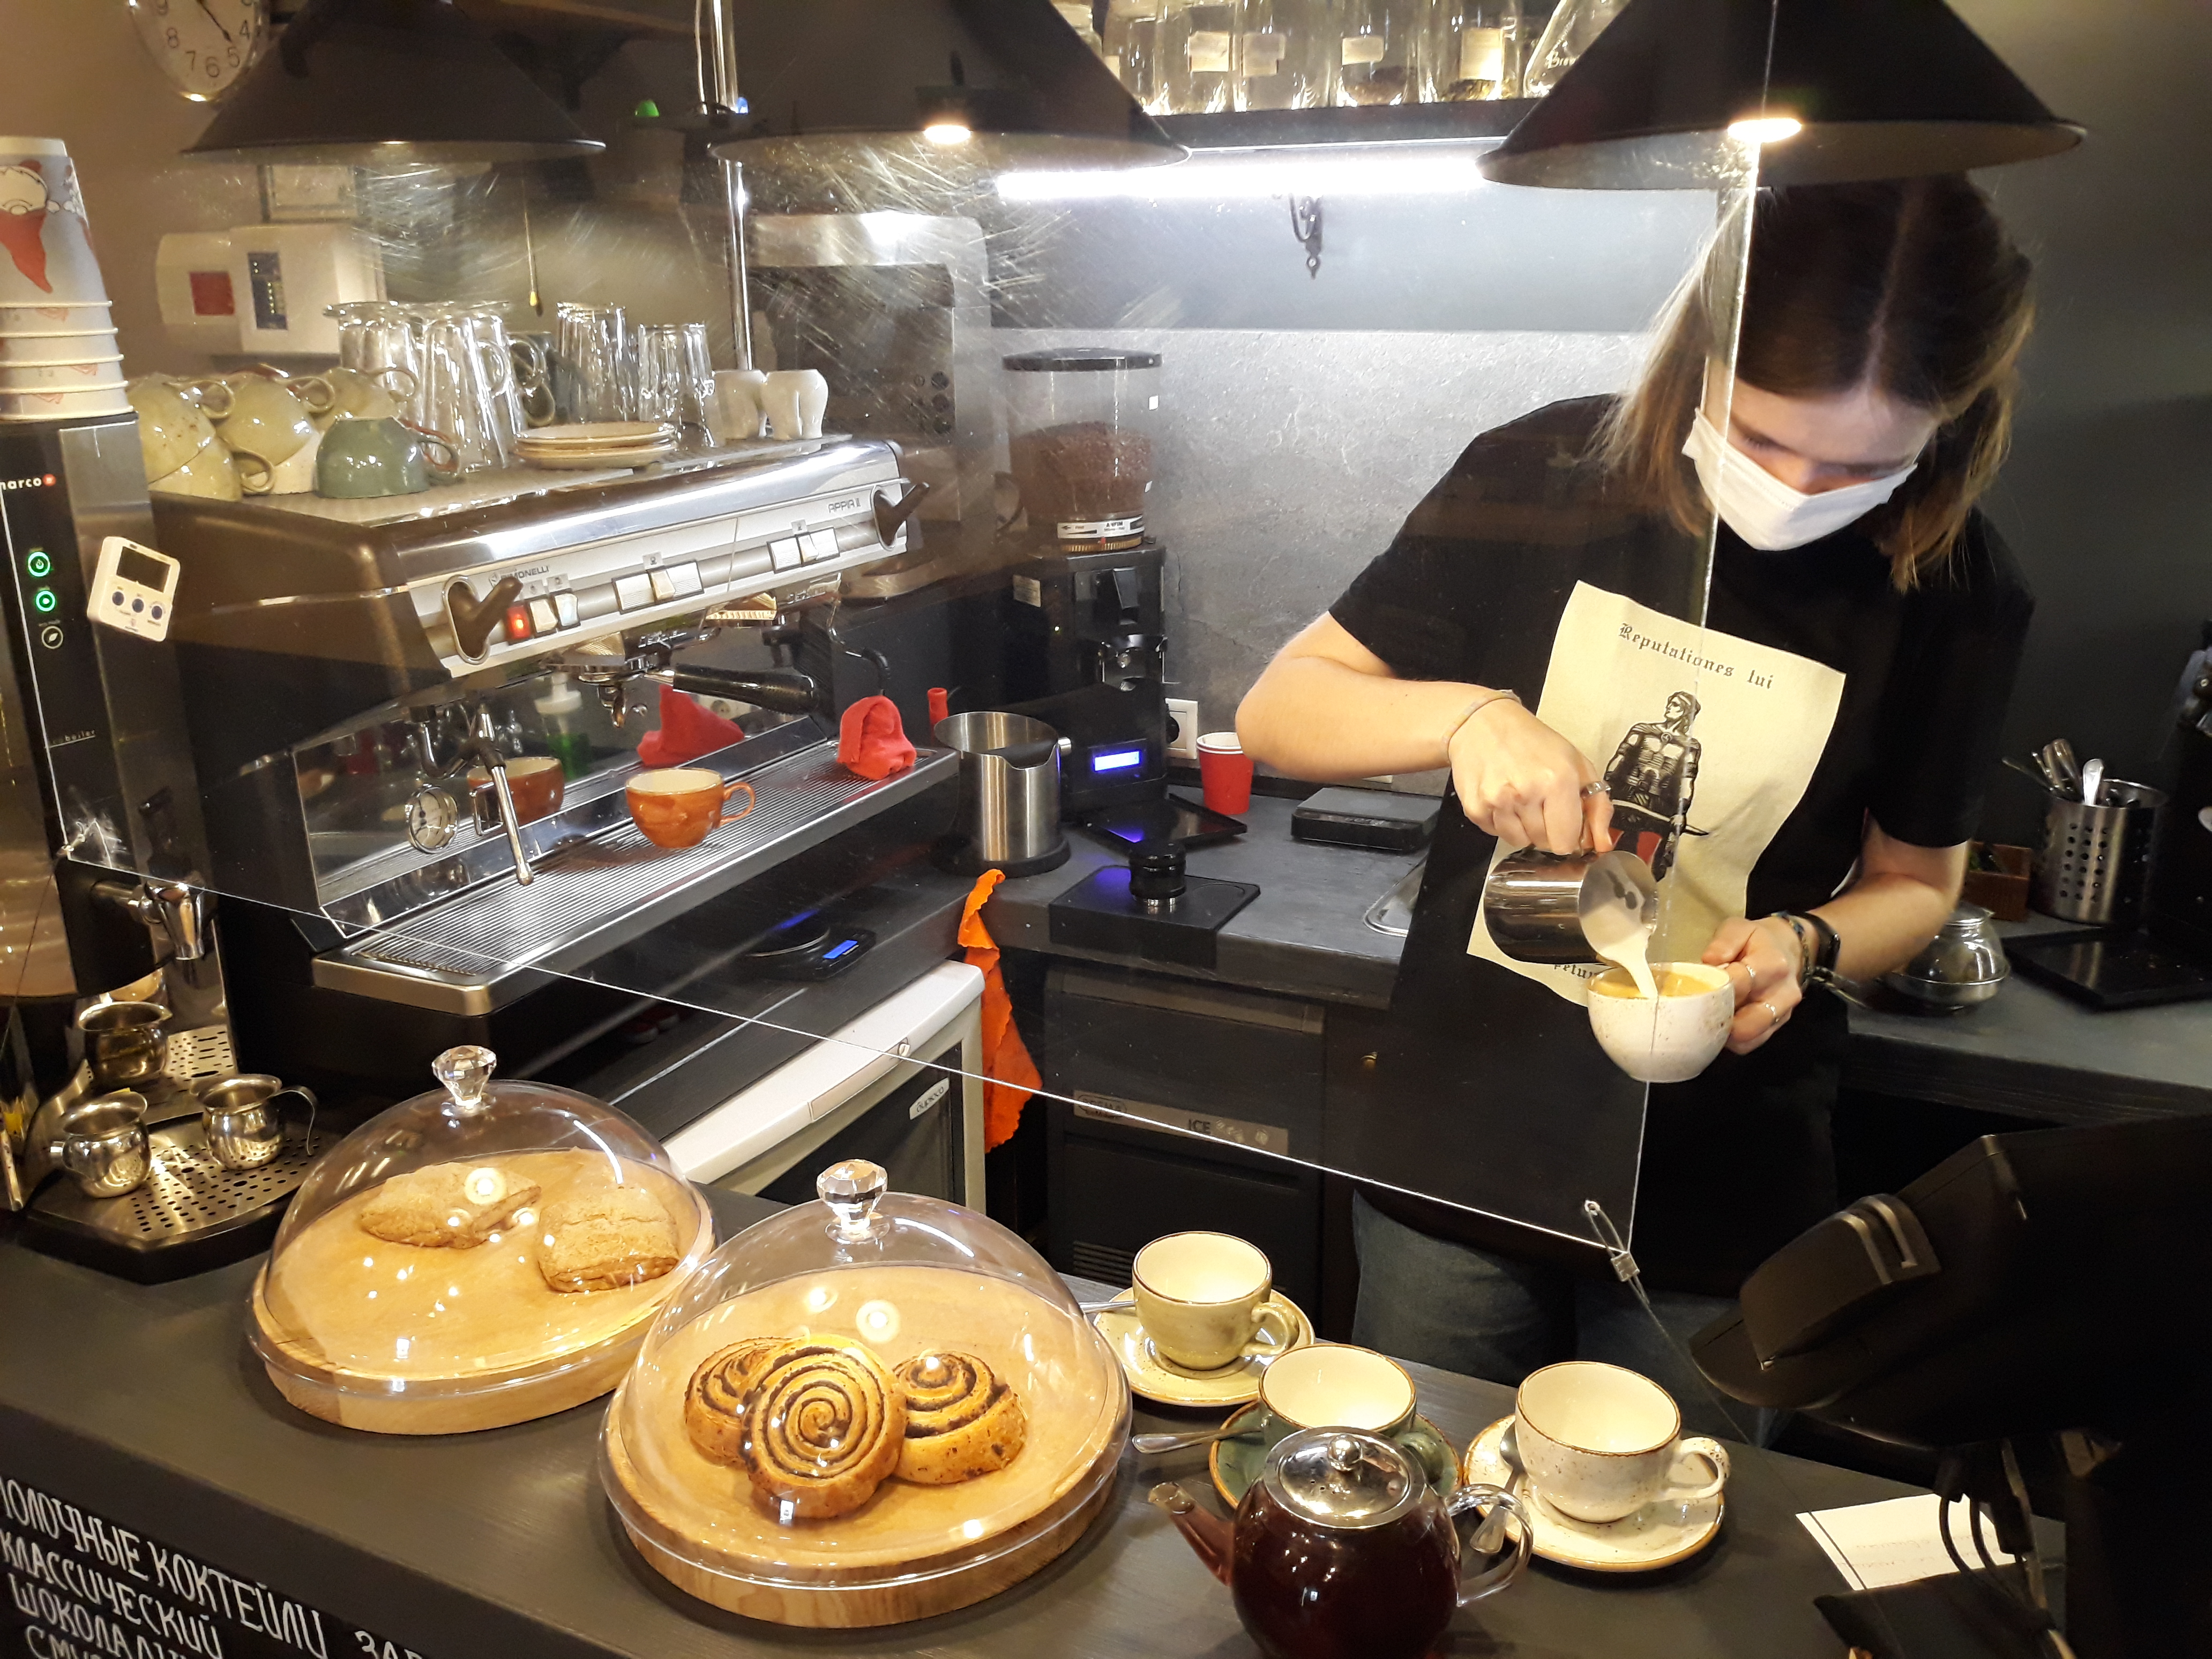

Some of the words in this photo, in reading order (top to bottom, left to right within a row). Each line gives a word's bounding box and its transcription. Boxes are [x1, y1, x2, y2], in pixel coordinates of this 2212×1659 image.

[166, 27, 180, 48] 8
[240, 19, 250, 40] 4
[185, 50, 196, 71] 7
[205, 56, 219, 77] 6
[227, 46, 240, 68] 5
[1618, 623, 1735, 677] Reputationes
[1746, 669, 1774, 689] lui
[1188, 1118, 1211, 1133] ICE
[0, 1529, 225, 1659] КЛАССИЧЕСКИЙ
[147, 1541, 328, 1659] КОКТЕЙЛИ
